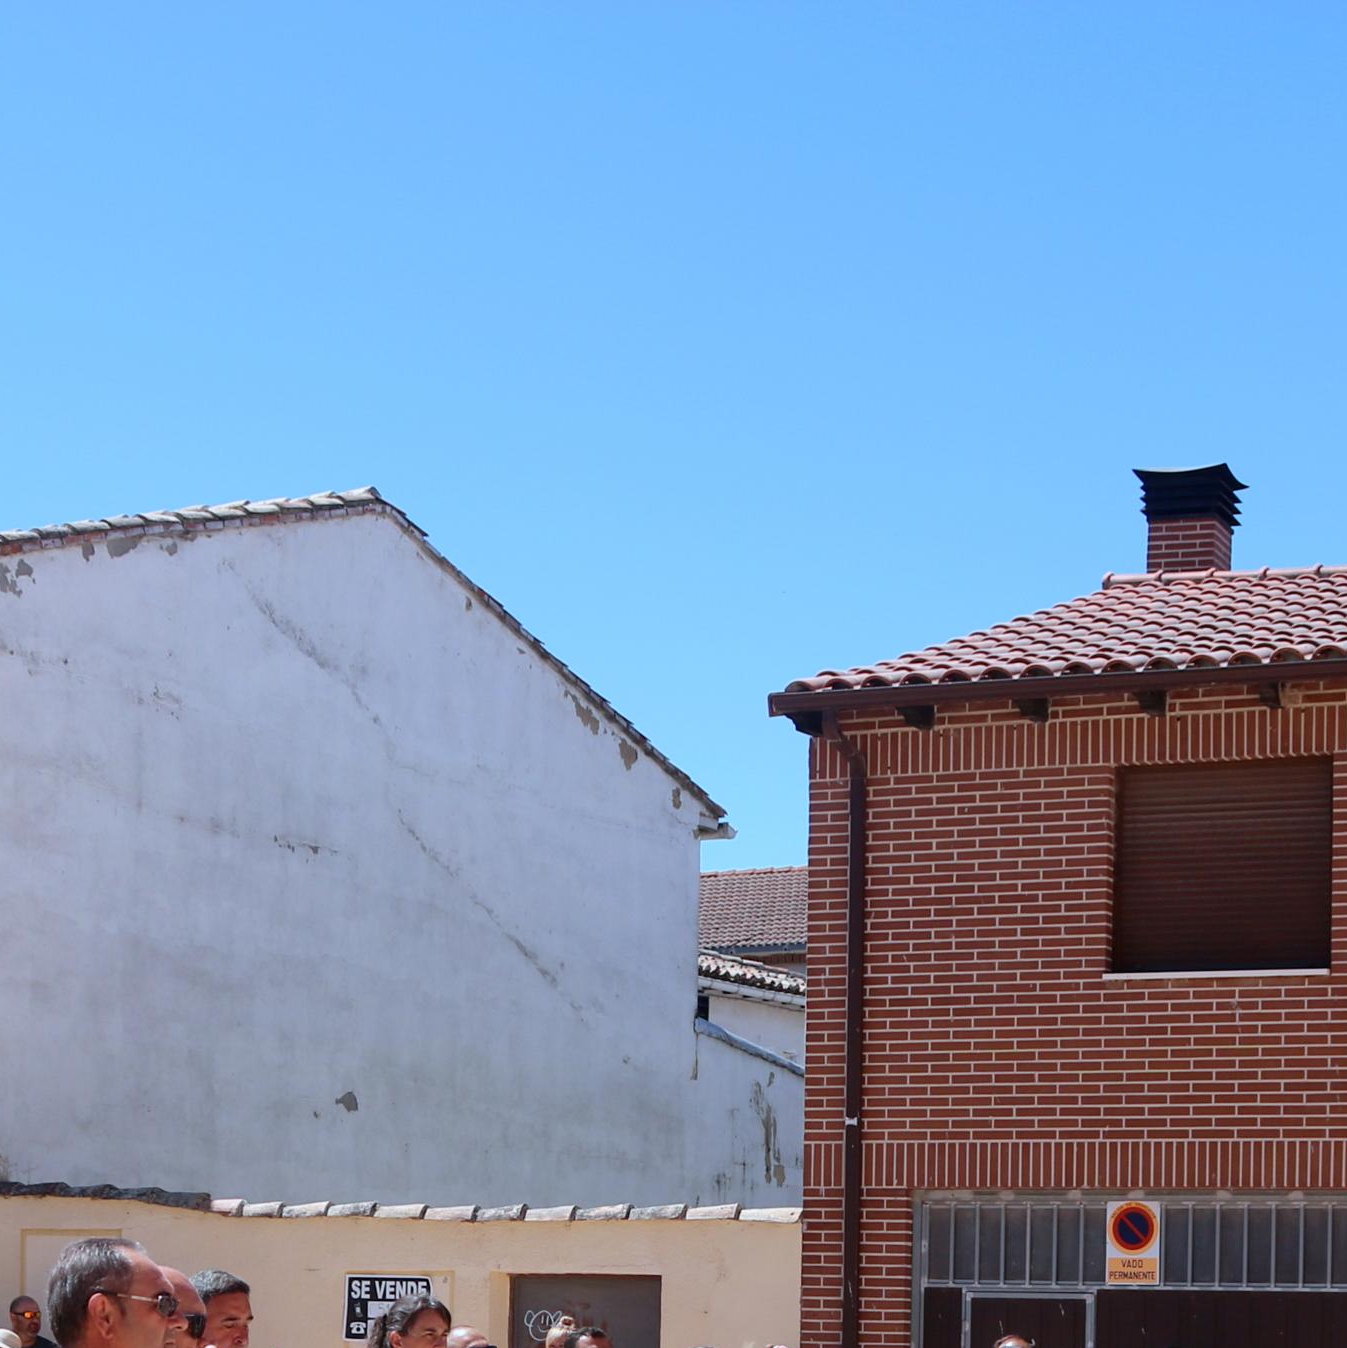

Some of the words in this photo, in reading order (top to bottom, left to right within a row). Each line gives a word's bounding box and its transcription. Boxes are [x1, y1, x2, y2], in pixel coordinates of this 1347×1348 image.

[1121, 1259, 1144, 1269] VADO
[1109, 1270, 1156, 1281] PERMANENTE
[350, 1279, 371, 1300] SE
[374, 1280, 428, 1300] VENDE
